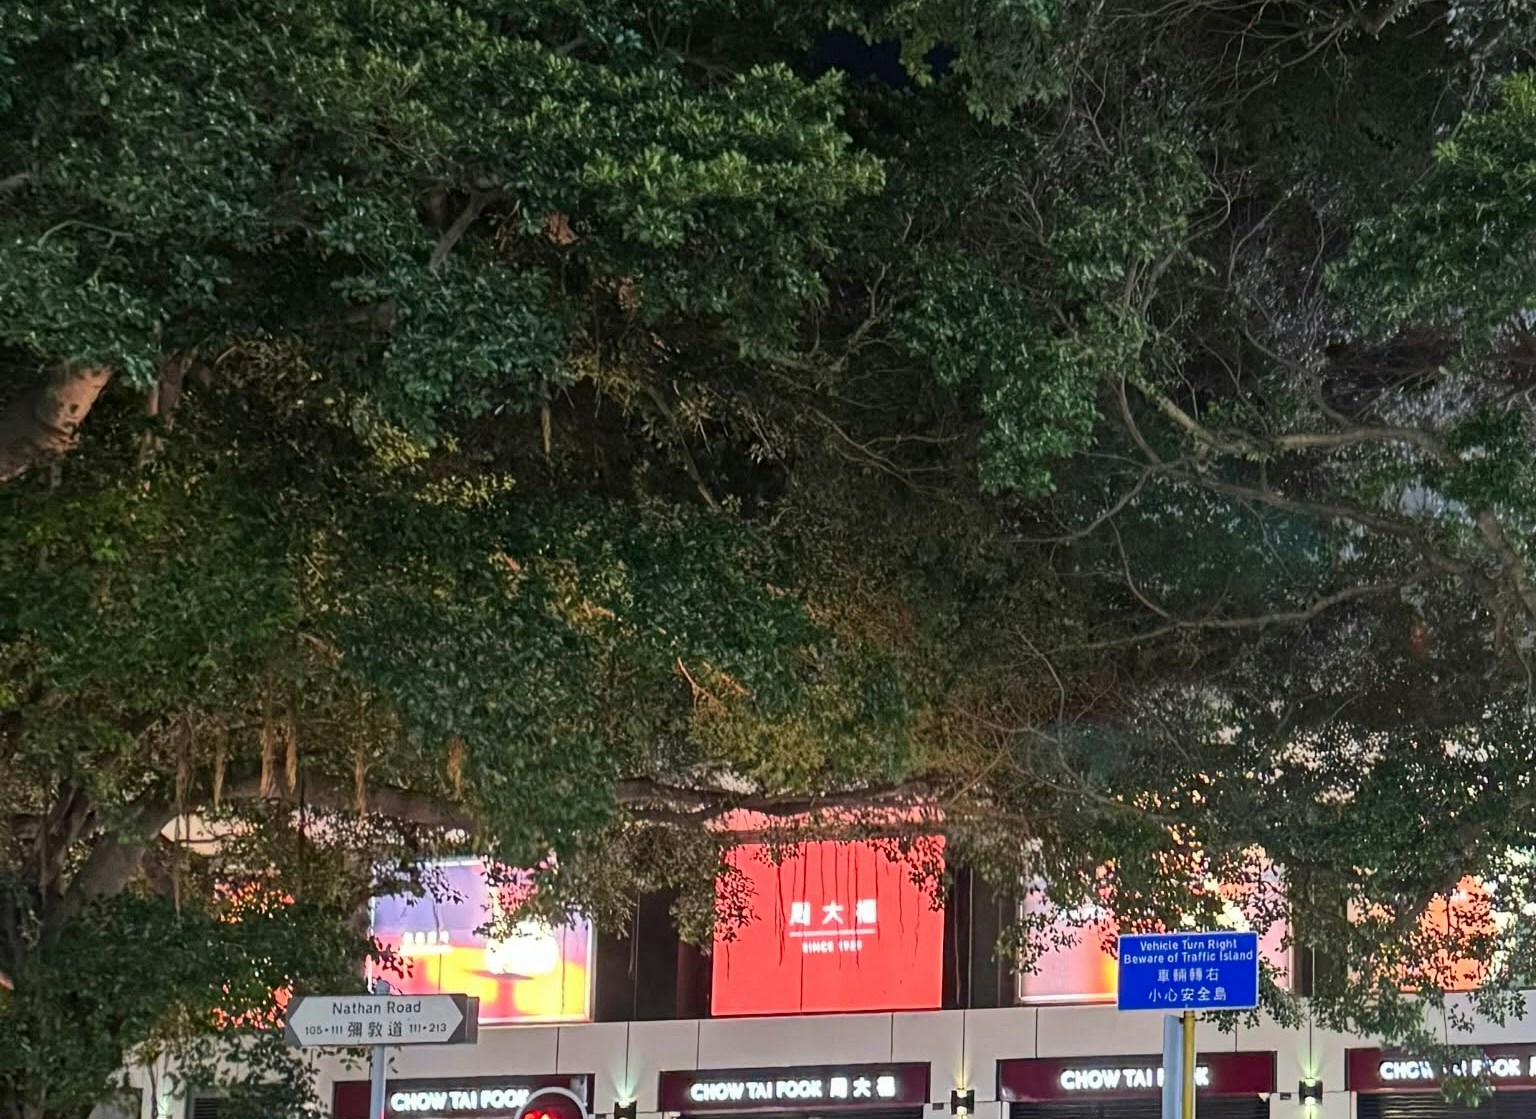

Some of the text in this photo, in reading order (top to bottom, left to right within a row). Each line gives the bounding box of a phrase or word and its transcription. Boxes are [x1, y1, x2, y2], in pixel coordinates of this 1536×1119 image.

[1140, 938, 1238, 952] Vehicle Turn Right
[1124, 949, 1254, 965] Beware of Traffic Island
[1148, 986, 1227, 1003] 小心安全島
[332, 1000, 422, 1016] Nathan Road
[347, 1021, 403, 1038] 彌敦道
[1060, 1068, 1121, 1090] CHOW
[1123, 1067, 1152, 1088] TAI
[690, 1083, 745, 1101] CHOW
[746, 1082, 773, 1099] TAI
[776, 1080, 822, 1099] FOOK
[390, 1091, 448, 1112] CHOW
[449, 1091, 479, 1110] TAI
